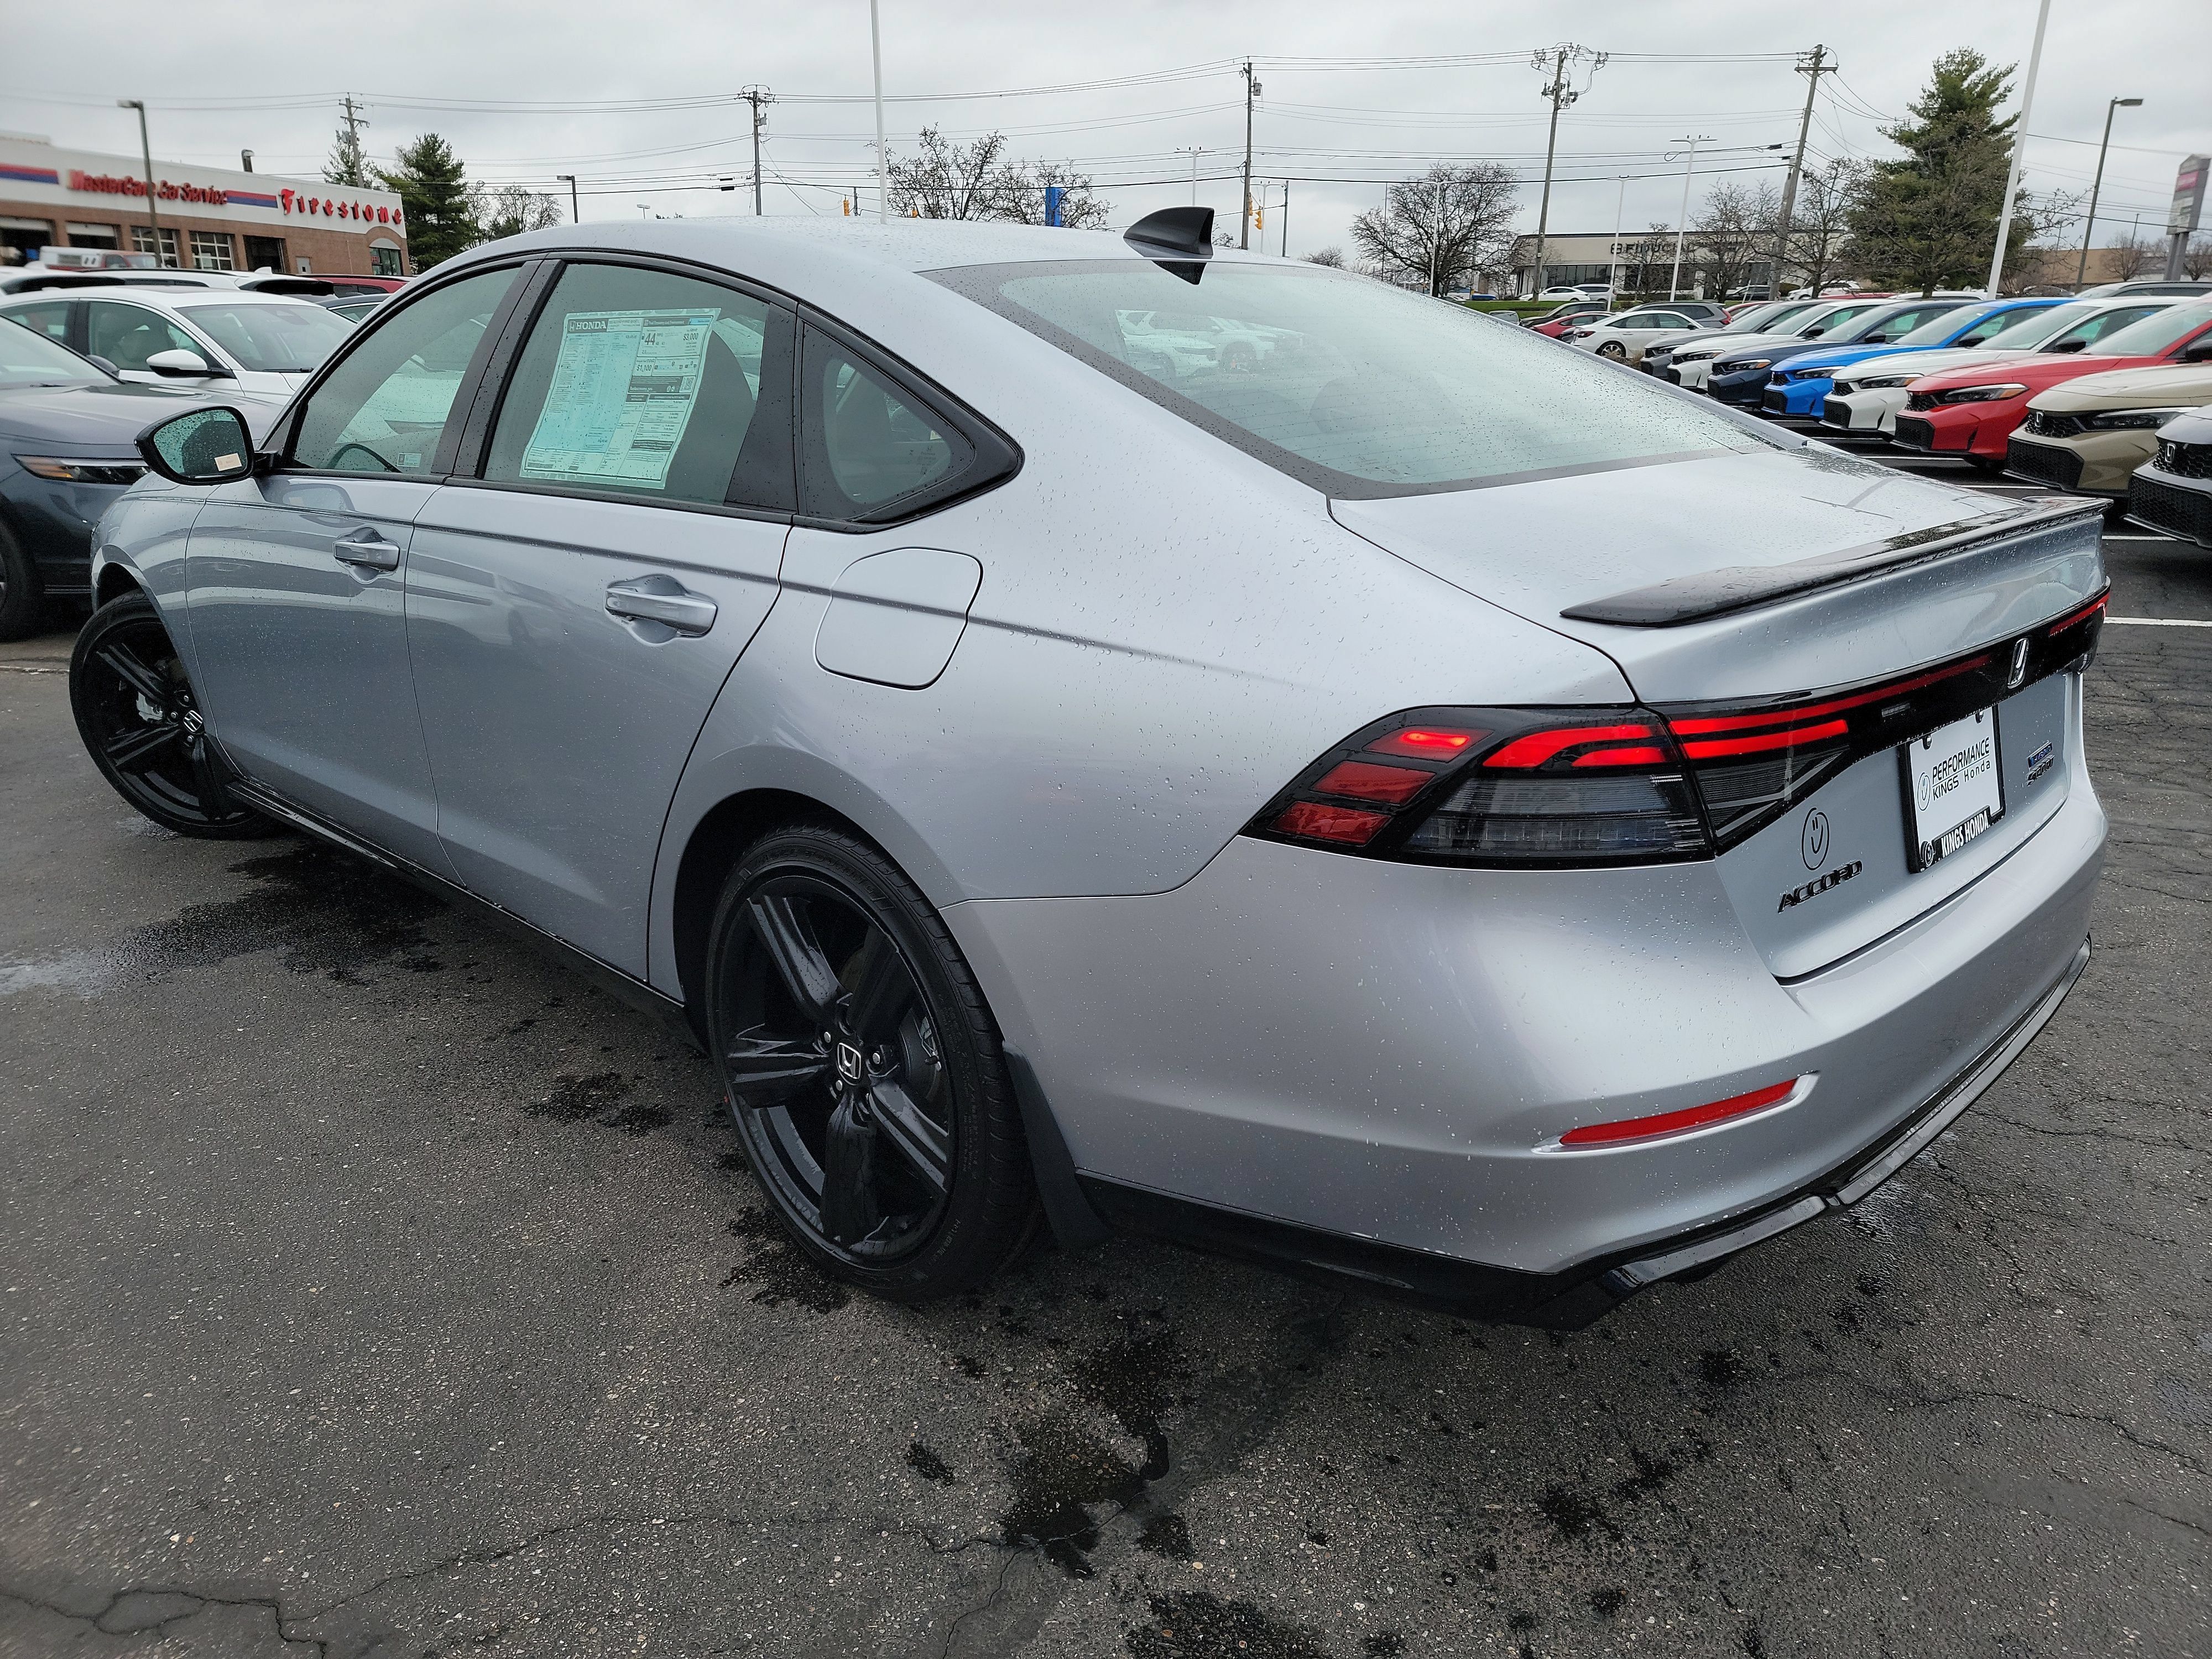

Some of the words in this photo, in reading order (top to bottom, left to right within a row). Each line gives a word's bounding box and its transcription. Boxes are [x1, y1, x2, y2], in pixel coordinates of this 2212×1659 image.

[157, 180, 179, 200] Car
[180, 182, 227, 205] Service
[278, 189, 402, 225] Firestone
[575, 321, 607, 330] HONDA
[644, 333, 656, 346] 44
[683, 333, 699, 341] $3,000
[1932, 737, 1990, 785] PERFORMANCE
[1932, 775, 1959, 801] KINGS
[1964, 759, 1991, 783] Honda
[1941, 827, 1964, 858] KINGS
[1964, 810, 1989, 842] HONDA
[1777, 859, 1863, 914] ACCORD
